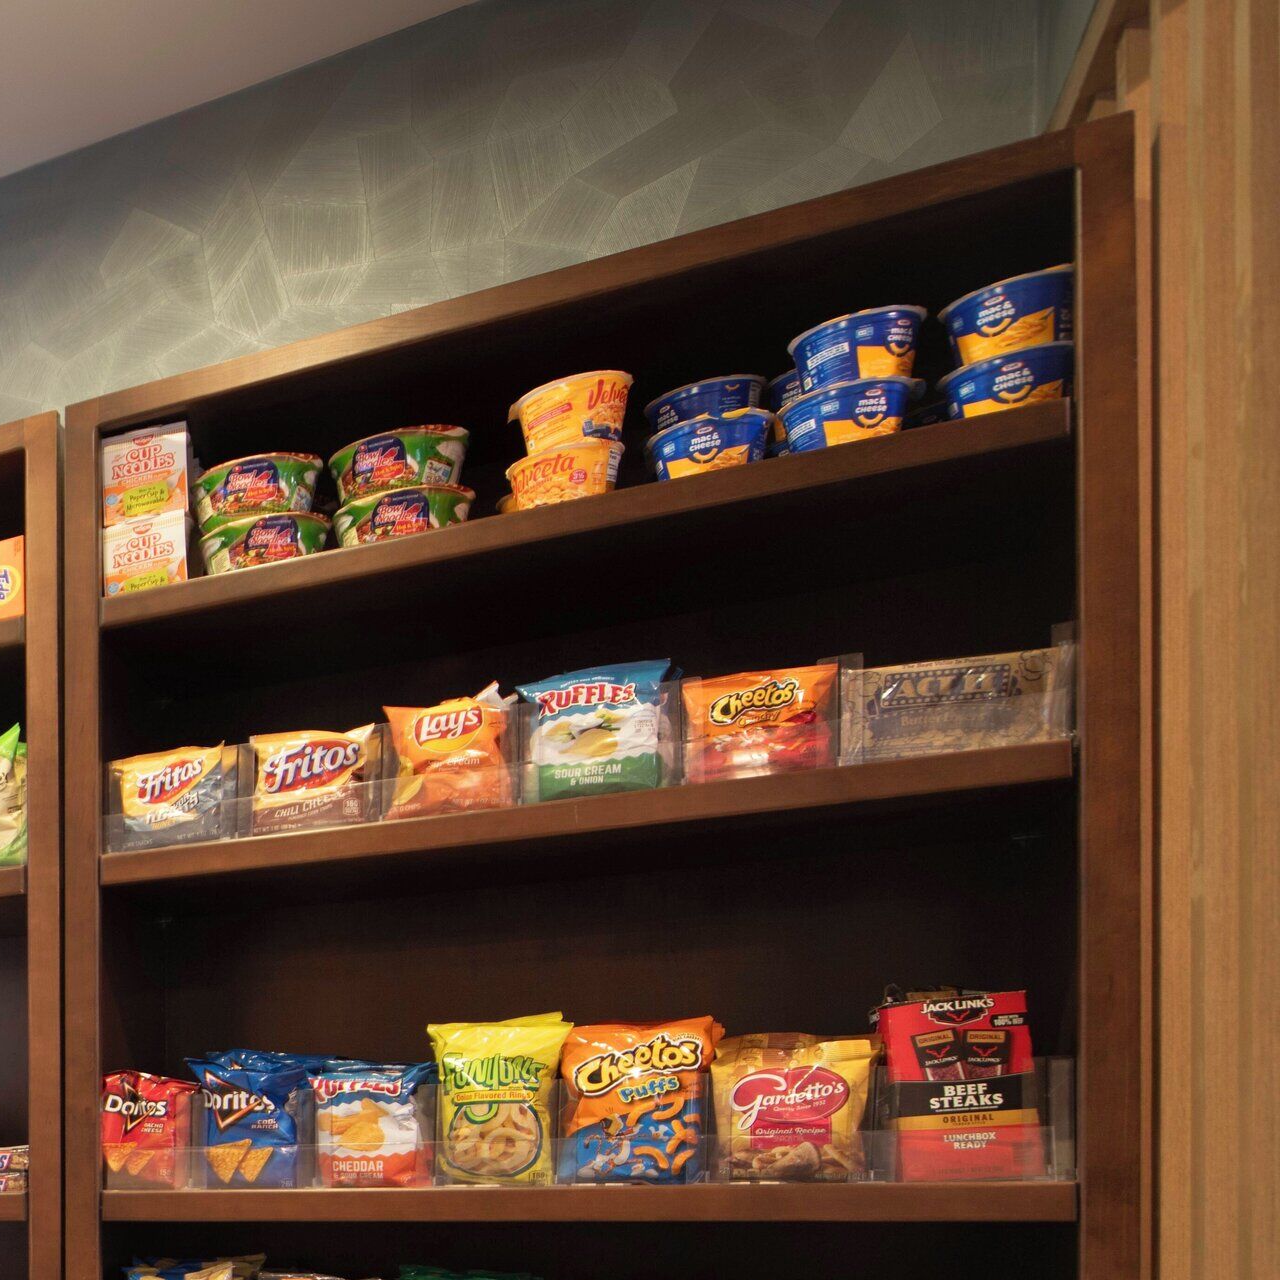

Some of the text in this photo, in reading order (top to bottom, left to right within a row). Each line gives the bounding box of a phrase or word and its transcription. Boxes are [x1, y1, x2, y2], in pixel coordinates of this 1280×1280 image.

[588, 379, 629, 410] Velve
[126, 444, 162, 462] CUP
[112, 453, 175, 480] NOODLES
[126, 533, 162, 550] CUP
[113, 541, 174, 568] NOODLES
[893, 675, 957, 698] ACT
[536, 682, 636, 720] RUFFLES
[711, 681, 796, 724] Cheetos
[420, 706, 482, 742] Lay's
[264, 741, 360, 793] Fritos
[554, 764, 621, 779] SOUR CREAM
[136, 758, 205, 803] Fritos
[579, 776, 604, 785] ONION
[275, 805, 299, 818] CHILI
[921, 998, 995, 1014] JACK LINK'S
[576, 1036, 701, 1093] Cheetos
[474, 1091, 507, 1100] Flavored
[943, 1083, 988, 1097] BEEF
[105, 1095, 167, 1116] Doritos
[202, 1090, 276, 1113] Doritos
[731, 1073, 845, 1131] Gardetto's
[929, 1093, 1004, 1110] STEAKS
[943, 1114, 994, 1124] ORIGINAL
[756, 1127, 826, 1137] Original Recipe
[944, 1132, 996, 1143] LUNCHBOX
[954, 1140, 988, 1150] READY
[333, 1160, 384, 1172] CHEDDAR
